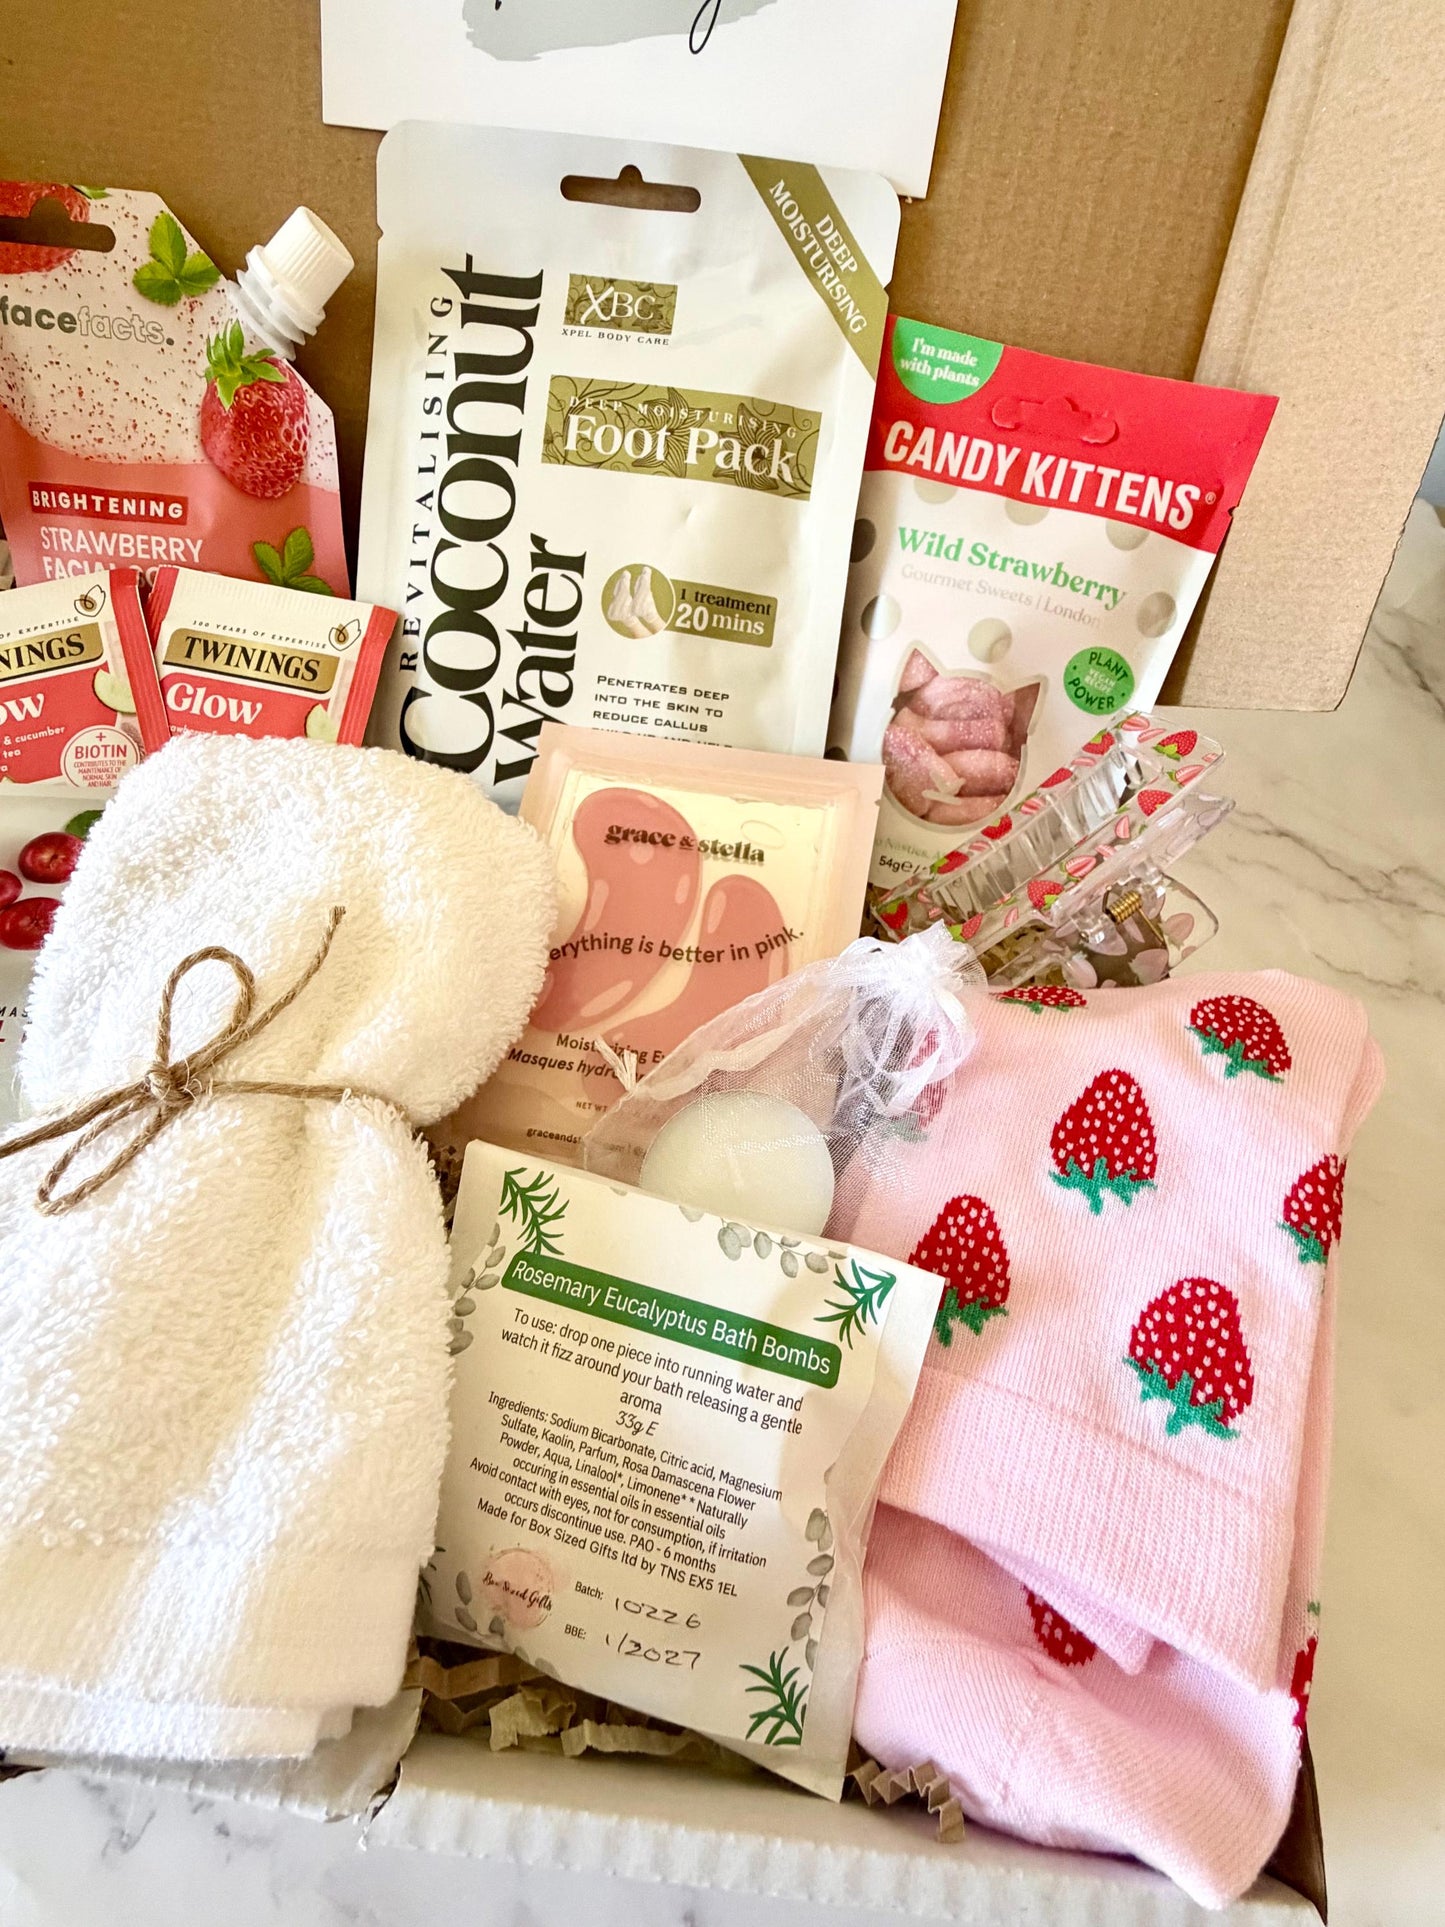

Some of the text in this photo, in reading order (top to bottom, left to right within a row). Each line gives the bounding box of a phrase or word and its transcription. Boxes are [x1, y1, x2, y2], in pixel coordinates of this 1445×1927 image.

[769, 178, 867, 334] MOISTURISING
[815, 214, 858, 273] DEEP
[581, 284, 655, 325] XBC
[562, 328, 670, 346] XPEL BODY CARE
[912, 337, 978, 368] I'm made
[901, 357, 980, 388] with plants
[569, 395, 798, 439] DEEP MOISTURISING
[564, 413, 797, 483] Foot Pack
[883, 420, 1022, 488] CANDY
[32, 490, 184, 518] BRIGHTENING
[399, 297, 453, 673] REVITALISING
[399, 253, 544, 774] Coconut
[40, 526, 204, 564] STRAWBERRY
[898, 526, 1127, 611] Wild Strawberry
[681, 588, 773, 616] 1 treatment
[901, 563, 1101, 630] Gourmet Sweets London
[19, 616, 78, 635] EXPERTISE
[216, 623, 247, 634] YEARS
[271, 634, 327, 649] EXPERTISE
[675, 603, 765, 636] 20 mins
[185, 636, 320, 683] TWININGS
[1089, 652, 1128, 681] PLANT
[166, 682, 263, 725] Glow
[595, 693, 724, 718] INTO THE SKIN TO
[597, 675, 730, 701] PENETRATES DEEP
[1068, 677, 1115, 710] POWER
[15, 726, 65, 743] cucumber
[593, 711, 708, 733] REDUCE CALLUS
[75, 745, 127, 759] BIOTIN
[604, 824, 765, 863] grace & stella
[549, 926, 805, 963] erything is better in pink.
[508, 1048, 574, 1071] Masques
[576, 1101, 608, 1113] NET WT
[512, 1261, 830, 1374] Rosemary Eucalyptus Bath Bombs
[515, 1308, 803, 1411] To use: drop one piece into running water and
[502, 1329, 802, 1434] watch it fizz around your bath releasing a gentle
[616, 1411, 644, 1436] 33g
[620, 1392, 662, 1415] aroma
[488, 1391, 782, 1501] Ingredients: Sodium Bicarbonate, Citric acid, Magnesium
[501, 1414, 756, 1511] Sulfate, Kaolin, Parfum, Rosa Damascena Flower
[500, 1432, 540, 1458] Powder,
[543, 1448, 572, 1469] Aqua,
[697, 1500, 748, 1530] Naturally
[513, 1458, 725, 1539] occuring in essential oils in essential oils
[470, 1457, 766, 1567] Avoid contact with eyes, not for consumption, if irritation
[478, 1498, 737, 1597] Made for Box Sized Gifts ltd by TNS EX5 1EL
[505, 1492, 716, 1573] occurs discontinue use. PAO 6 months
[575, 1581, 701, 1629] Batch: 10226
[564, 1623, 587, 1640] BBE:
